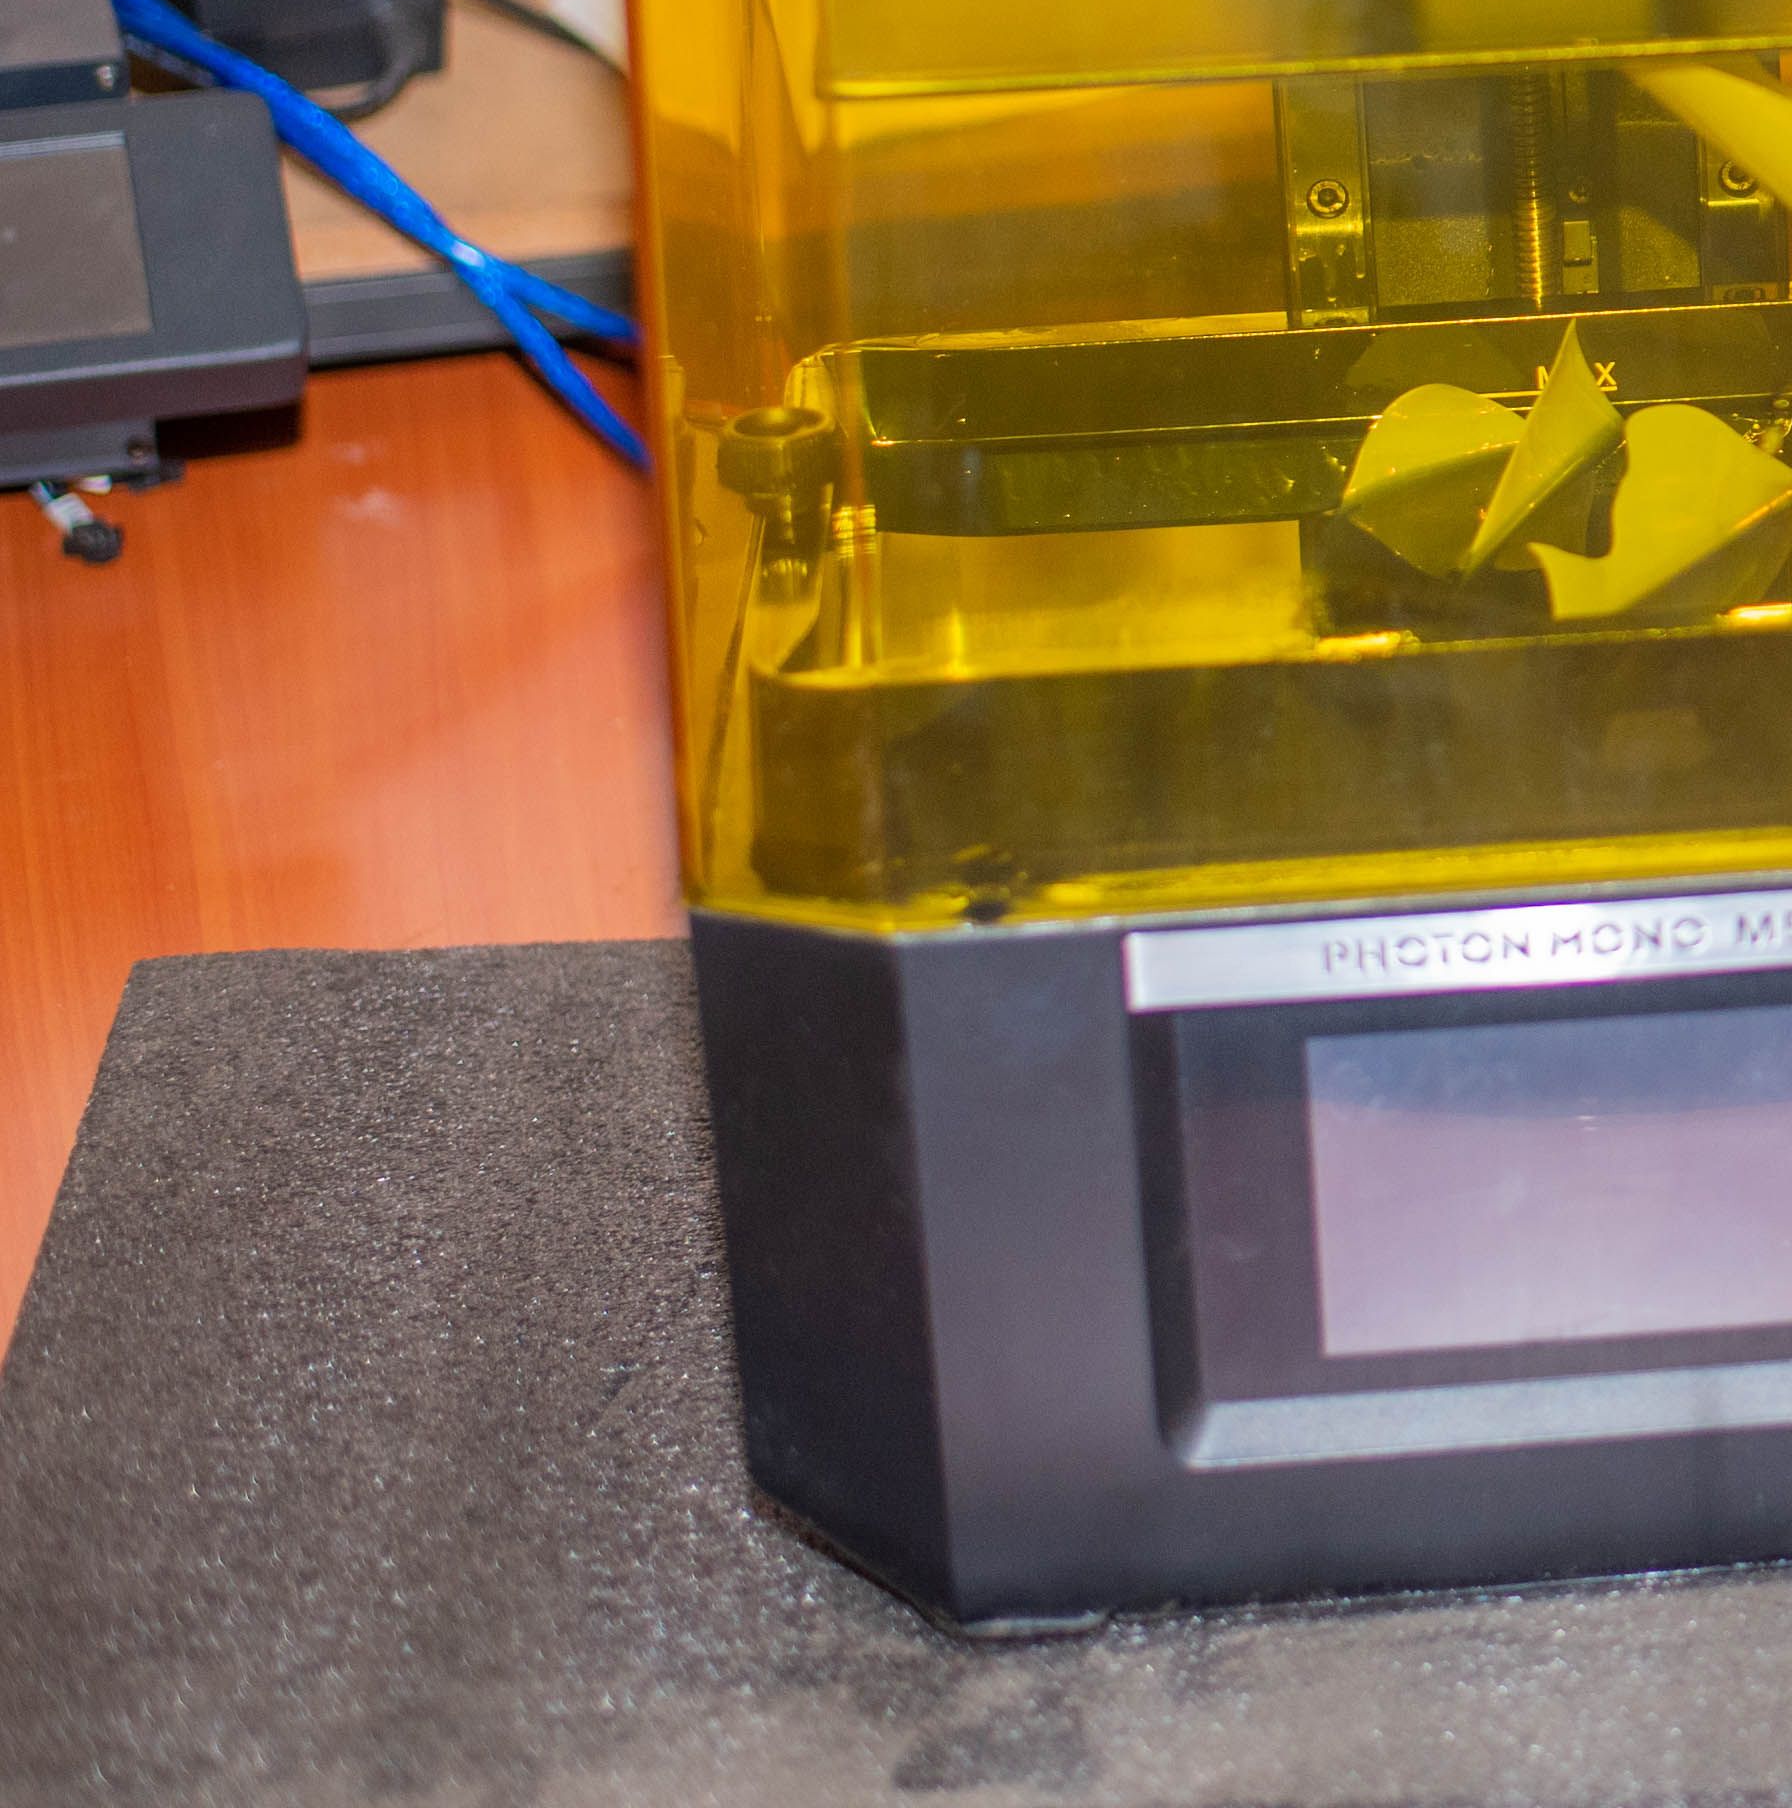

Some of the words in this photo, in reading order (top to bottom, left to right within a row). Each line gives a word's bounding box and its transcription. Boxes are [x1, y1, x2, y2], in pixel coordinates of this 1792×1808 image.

[1537, 361, 1617, 389] MX
[1322, 931, 1530, 973] PHOTON
[1551, 916, 1706, 956] MONO
